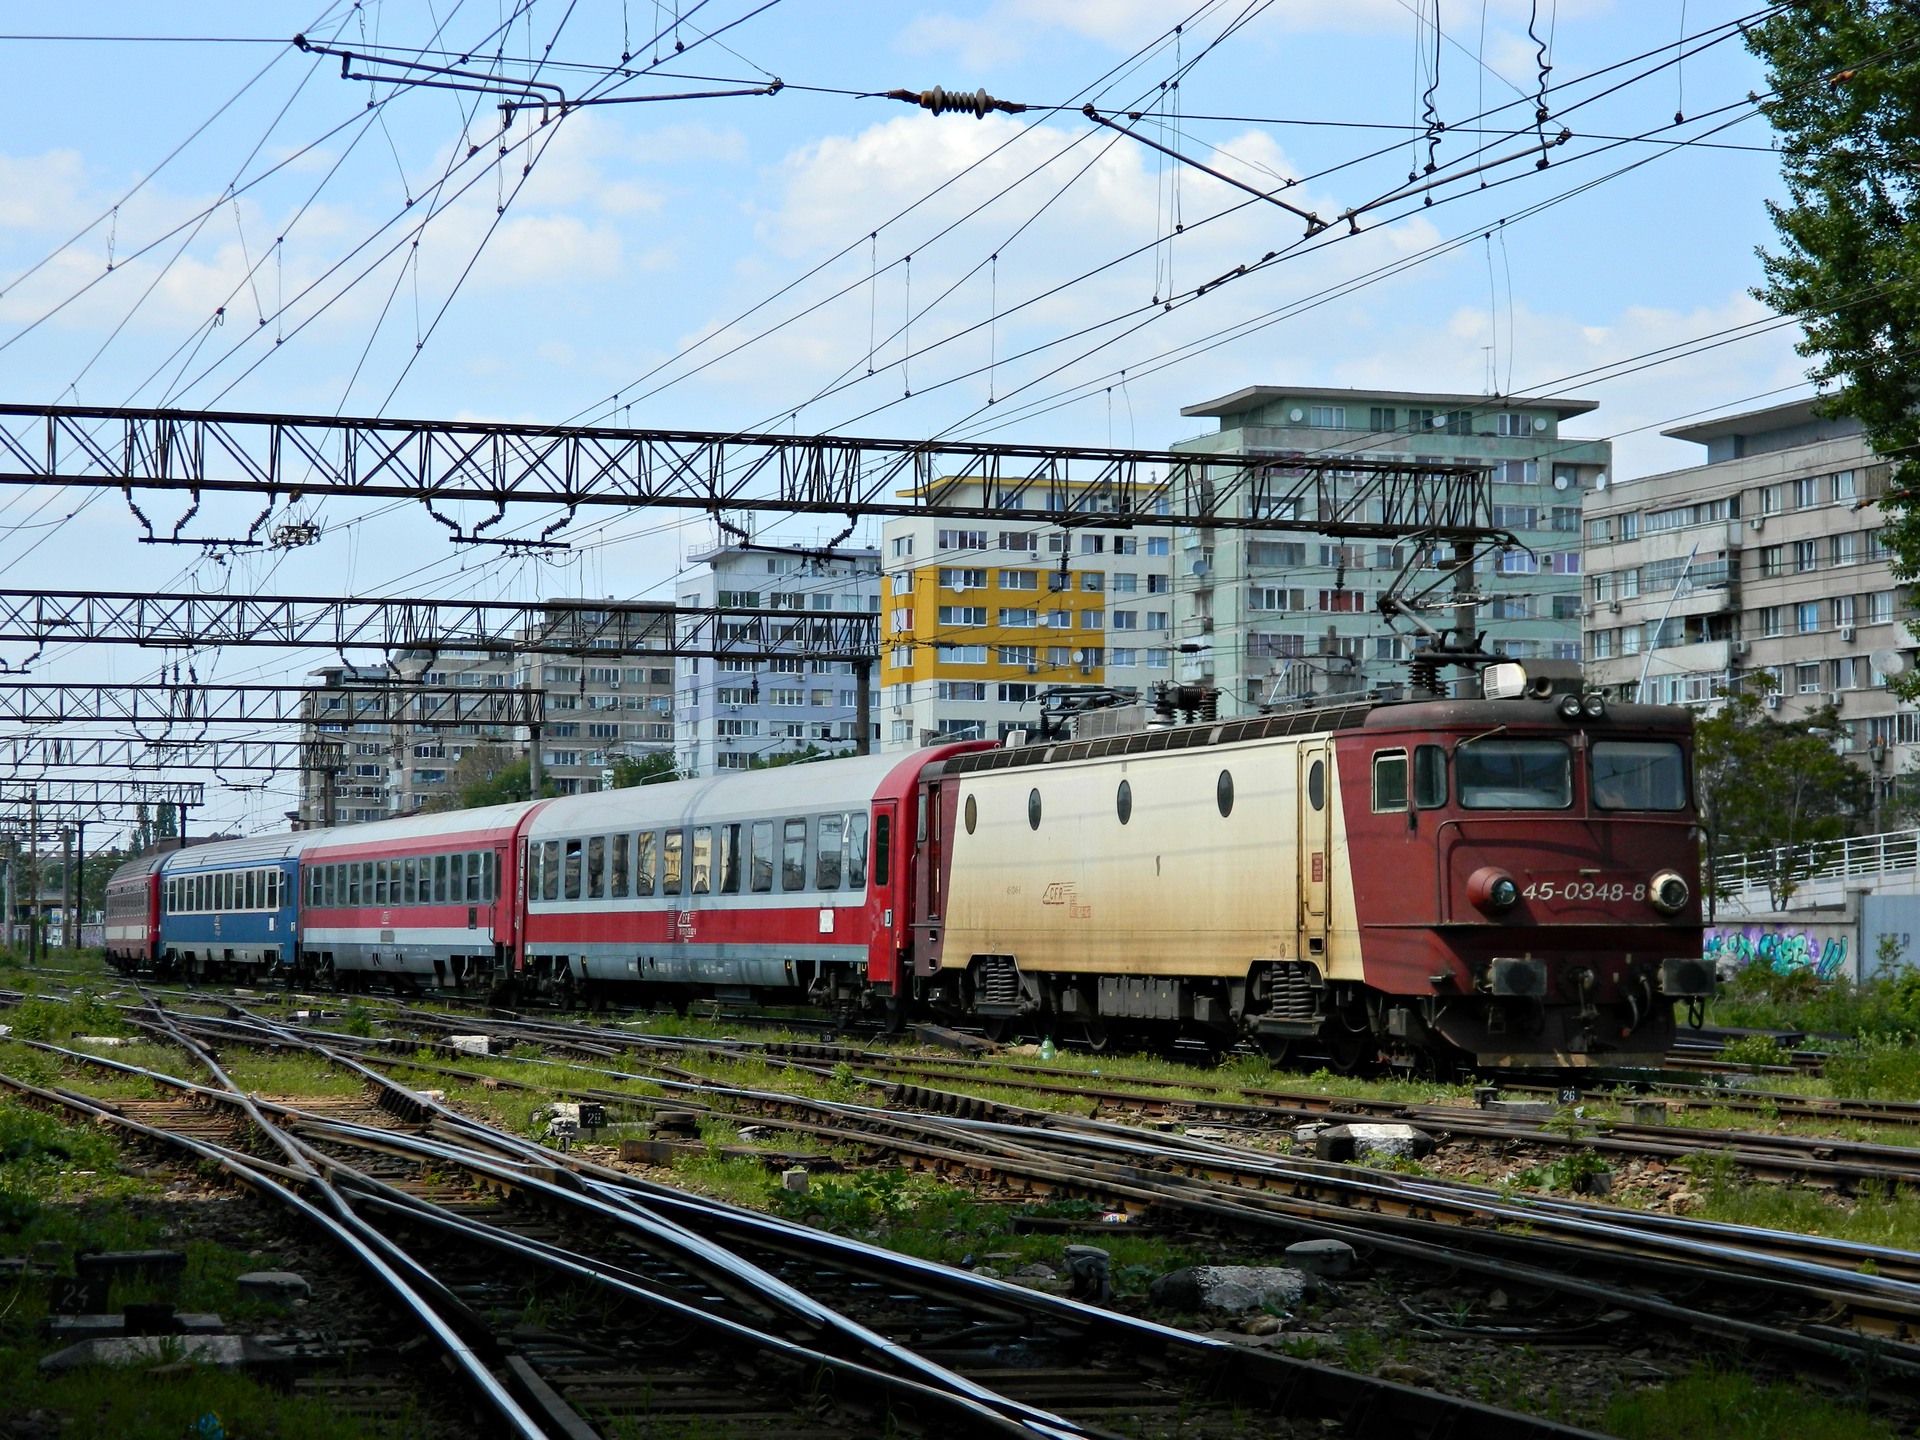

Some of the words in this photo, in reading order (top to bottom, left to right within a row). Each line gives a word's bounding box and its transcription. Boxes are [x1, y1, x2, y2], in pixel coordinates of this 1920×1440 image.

[843, 813, 850, 843] 2
[1049, 886, 1063, 901] CFR
[1522, 882, 1646, 901] 45-0348-8
[1563, 1089, 1576, 1101] 26
[62, 1284, 89, 1308] 24
